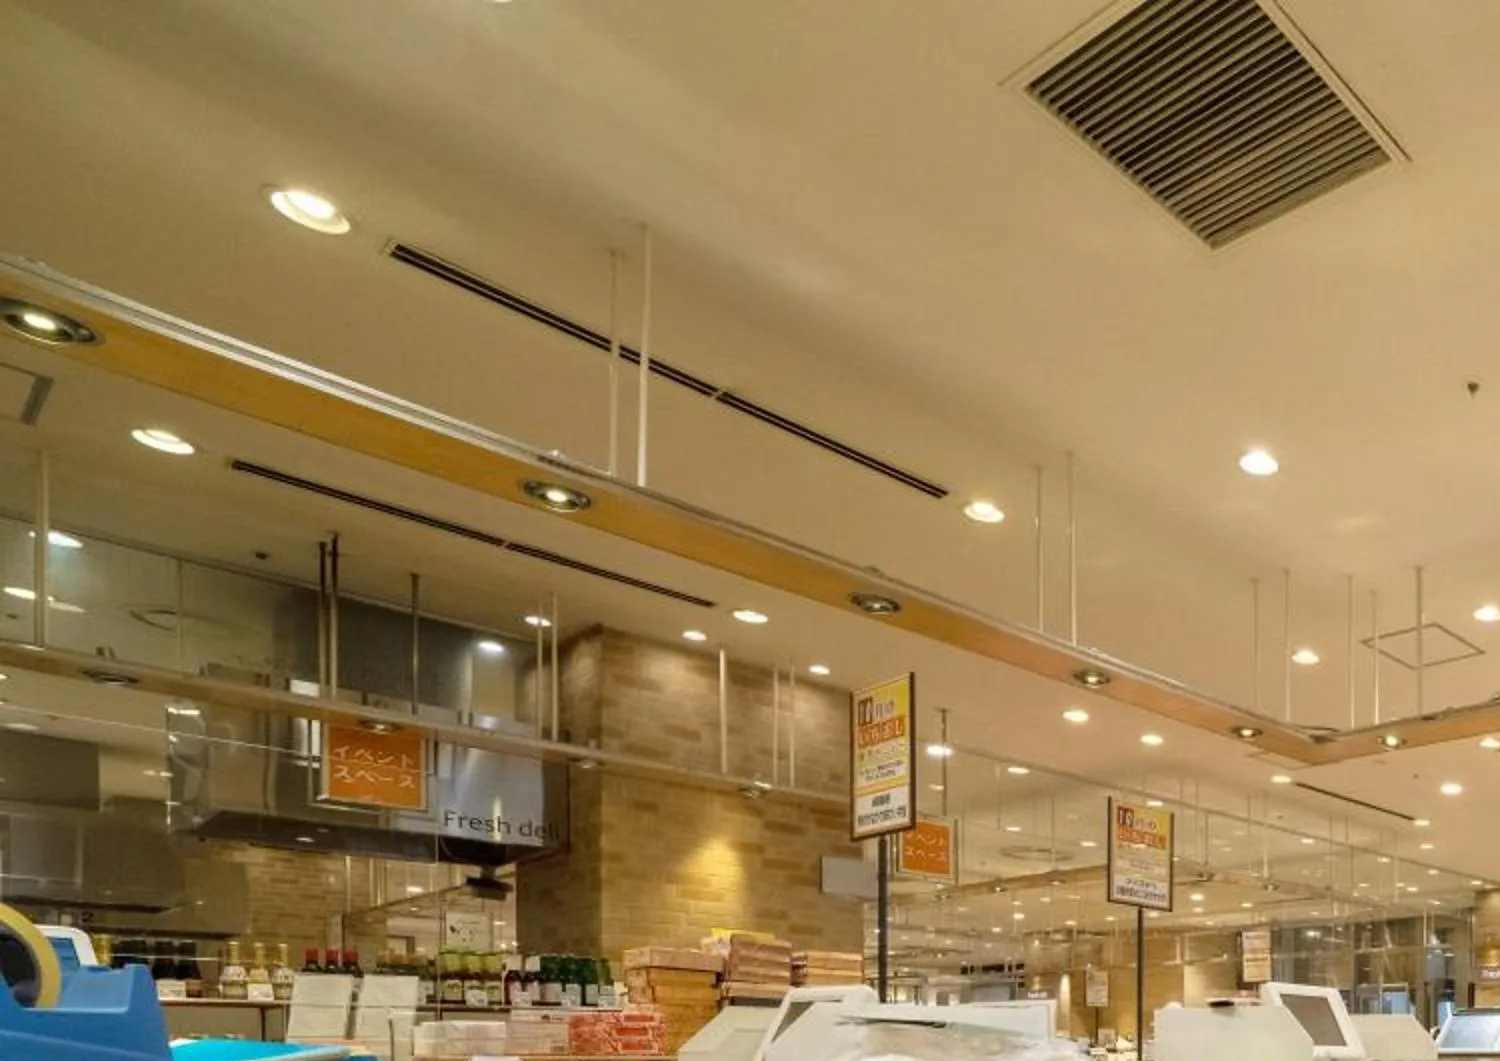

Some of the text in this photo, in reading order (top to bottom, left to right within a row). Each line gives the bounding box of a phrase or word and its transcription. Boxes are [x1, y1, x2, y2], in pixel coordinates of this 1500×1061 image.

[333, 764, 416, 790] スペース
[444, 811, 511, 837] Fresh
